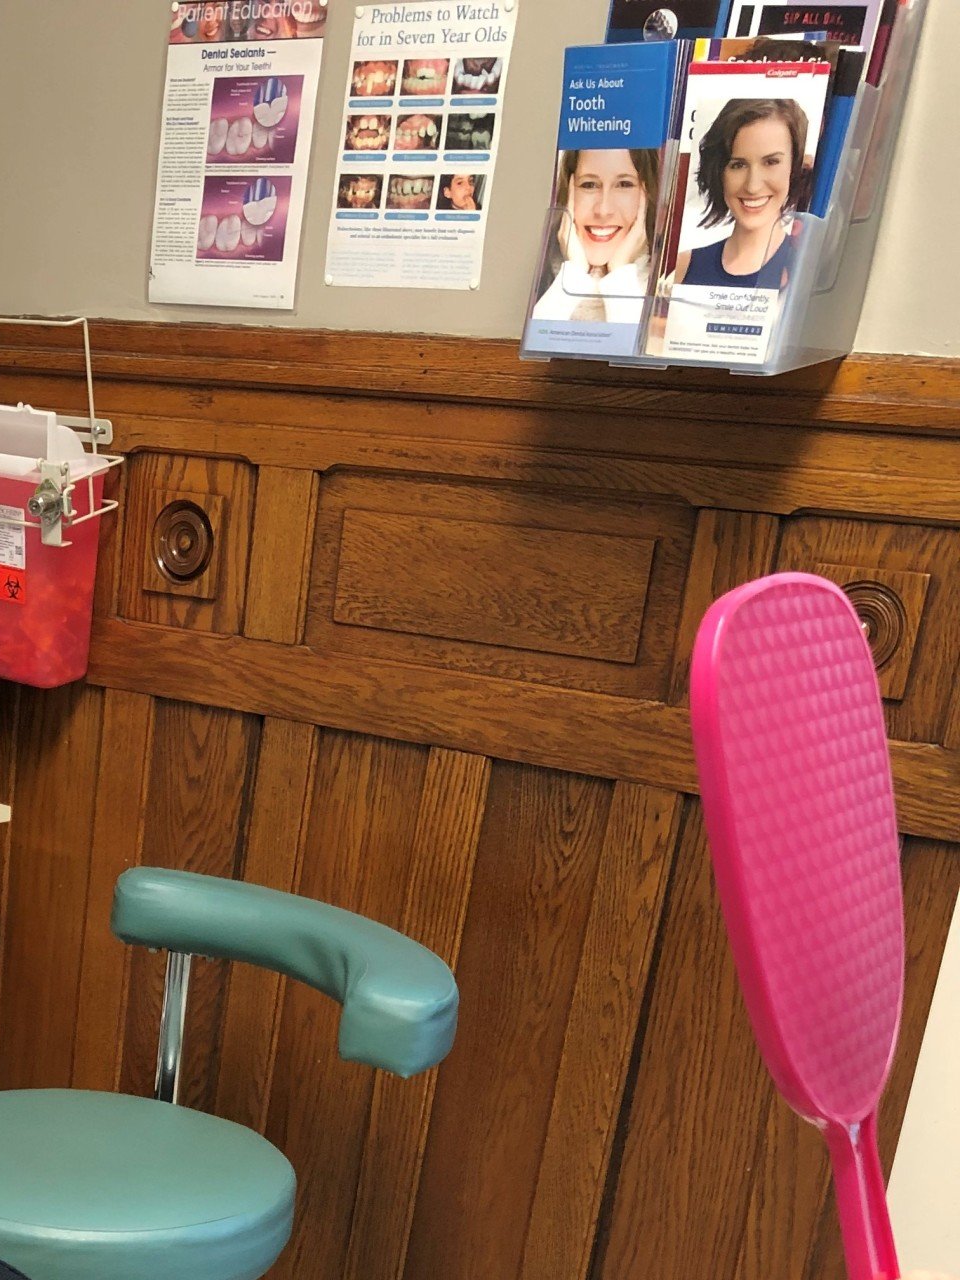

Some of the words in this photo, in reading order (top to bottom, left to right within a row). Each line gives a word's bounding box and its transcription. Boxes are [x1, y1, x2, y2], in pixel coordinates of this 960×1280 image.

[178, 3, 229, 22] Patient
[232, 0, 312, 20] Education
[371, 7, 431, 24] Problems
[437, 9, 450, 21] to
[456, 4, 499, 21] Watch
[784, 12, 800, 25] SIP
[802, 12, 819, 25] ALL
[357, 30, 375, 46] for
[379, 31, 392, 46] in
[397, 30, 435, 45] Seven
[442, 28, 470, 43] Year
[474, 26, 508, 42] Olds
[201, 48, 228, 60] Dental
[230, 47, 265, 59] Sealants
[203, 64, 224, 73] Armor
[225, 63, 234, 72] for
[236, 63, 250, 71] Your
[251, 62, 272, 71] Teeth!
[767, 69, 798, 77] Colgate
[569, 79, 584, 89] Ask
[586, 79, 596, 89] Us
[597, 78, 624, 88] About
[569, 95, 605, 111] Tooth
[568, 116, 631, 135] Whitening
[709, 291, 728, 300] Smile
[715, 303, 734, 311] Smile
[736, 304, 749, 312] Out
[750, 305, 769, 313] Loud
[708, 324, 761, 335] LUMINEERS
